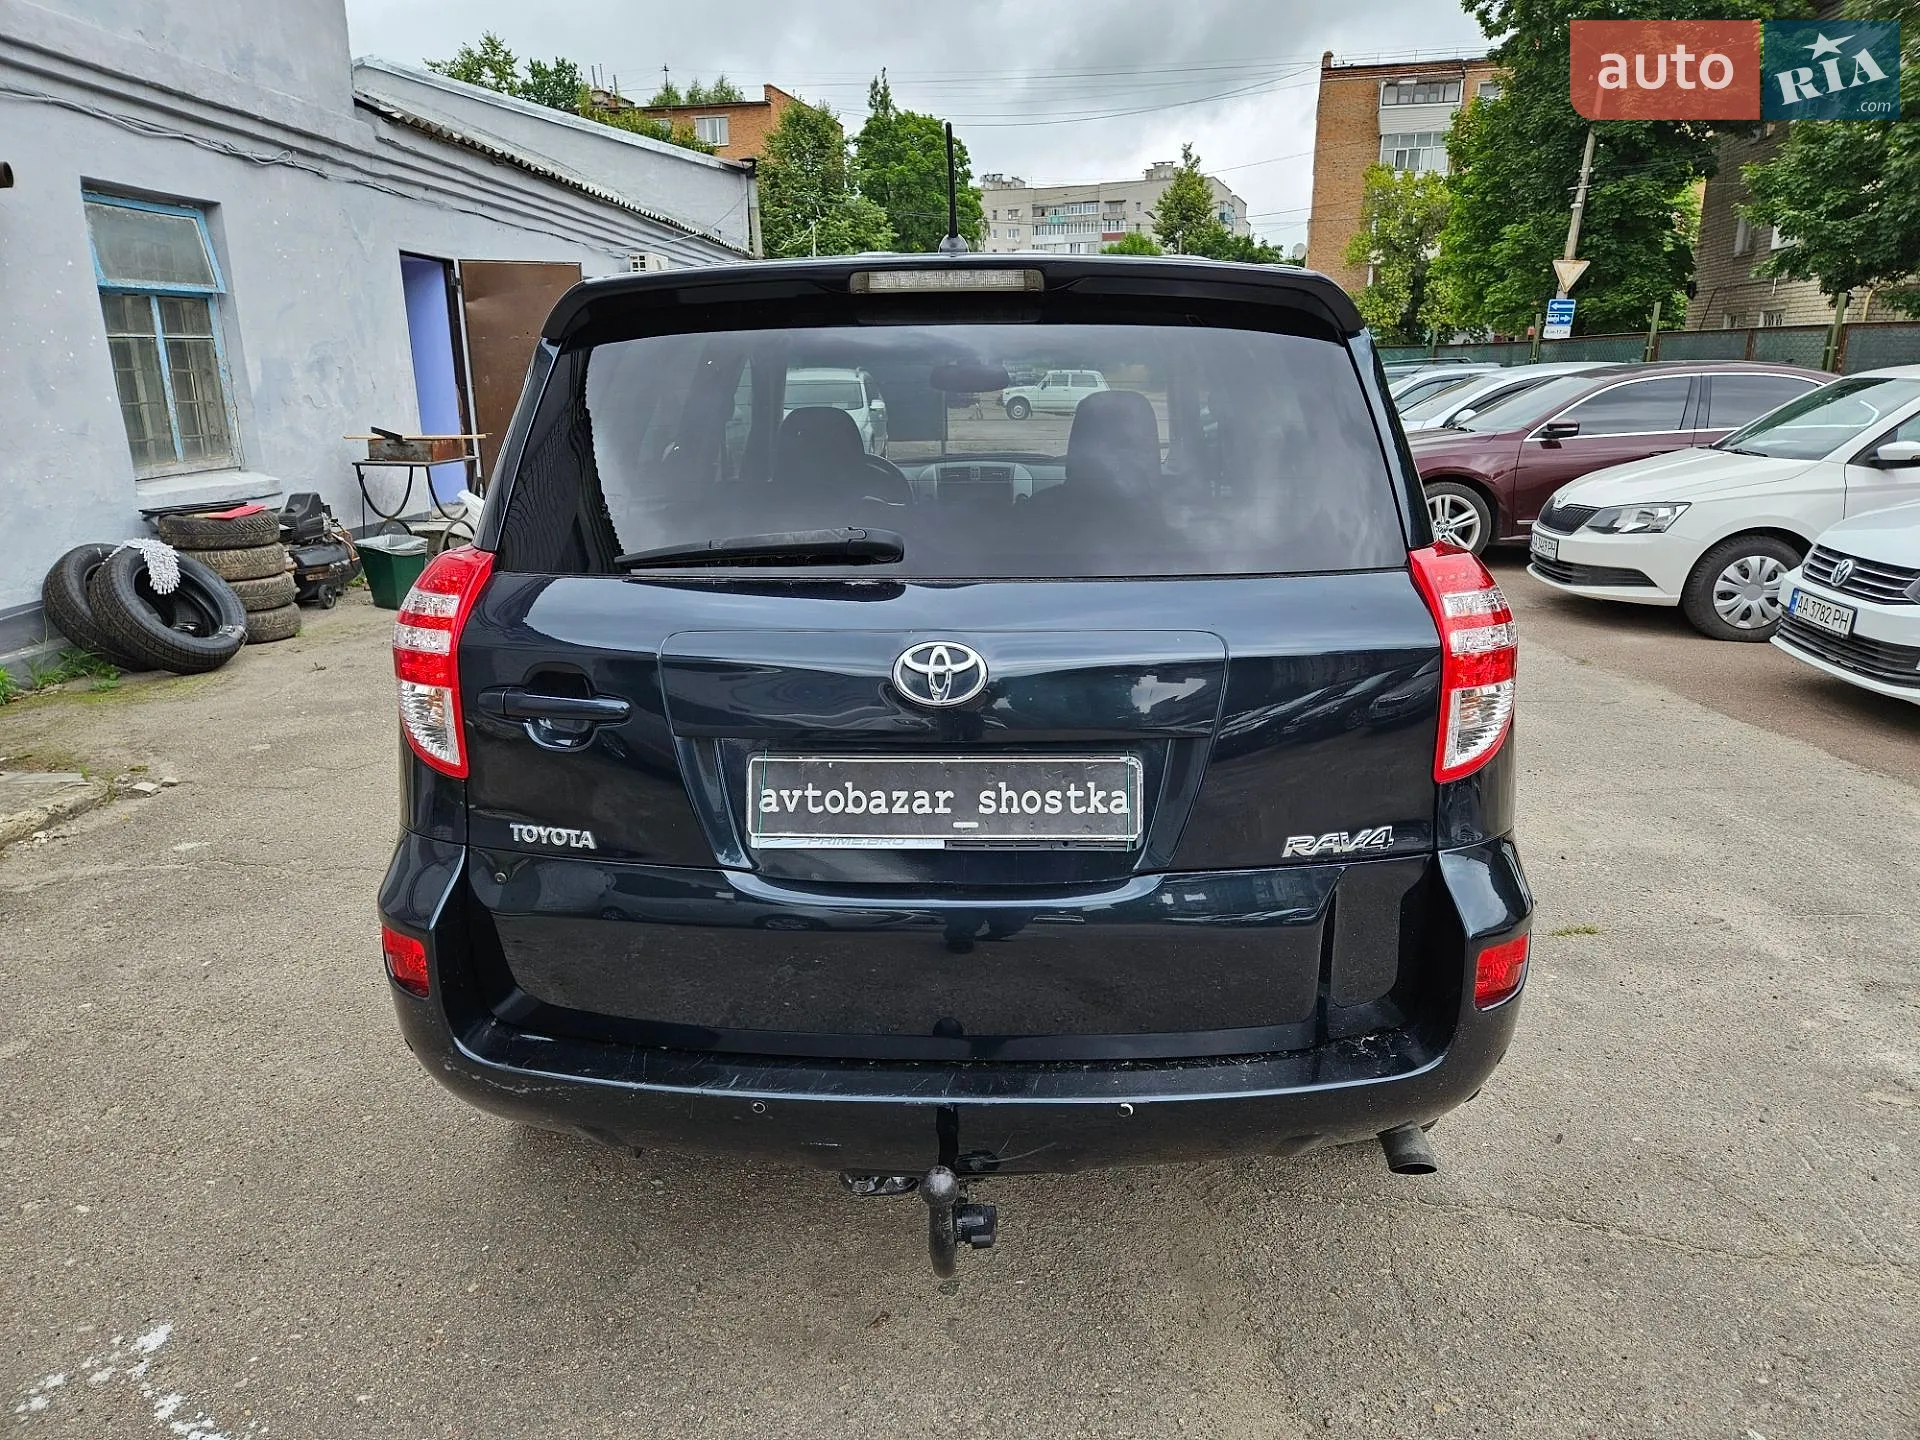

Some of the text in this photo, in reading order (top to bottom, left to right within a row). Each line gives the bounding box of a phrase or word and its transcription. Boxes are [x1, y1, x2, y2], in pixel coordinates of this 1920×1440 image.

[1796, 595, 1850, 630] AA 3782 PH
[509, 822, 597, 850] TOYOTA
[1281, 825, 1395, 858] RAV4
